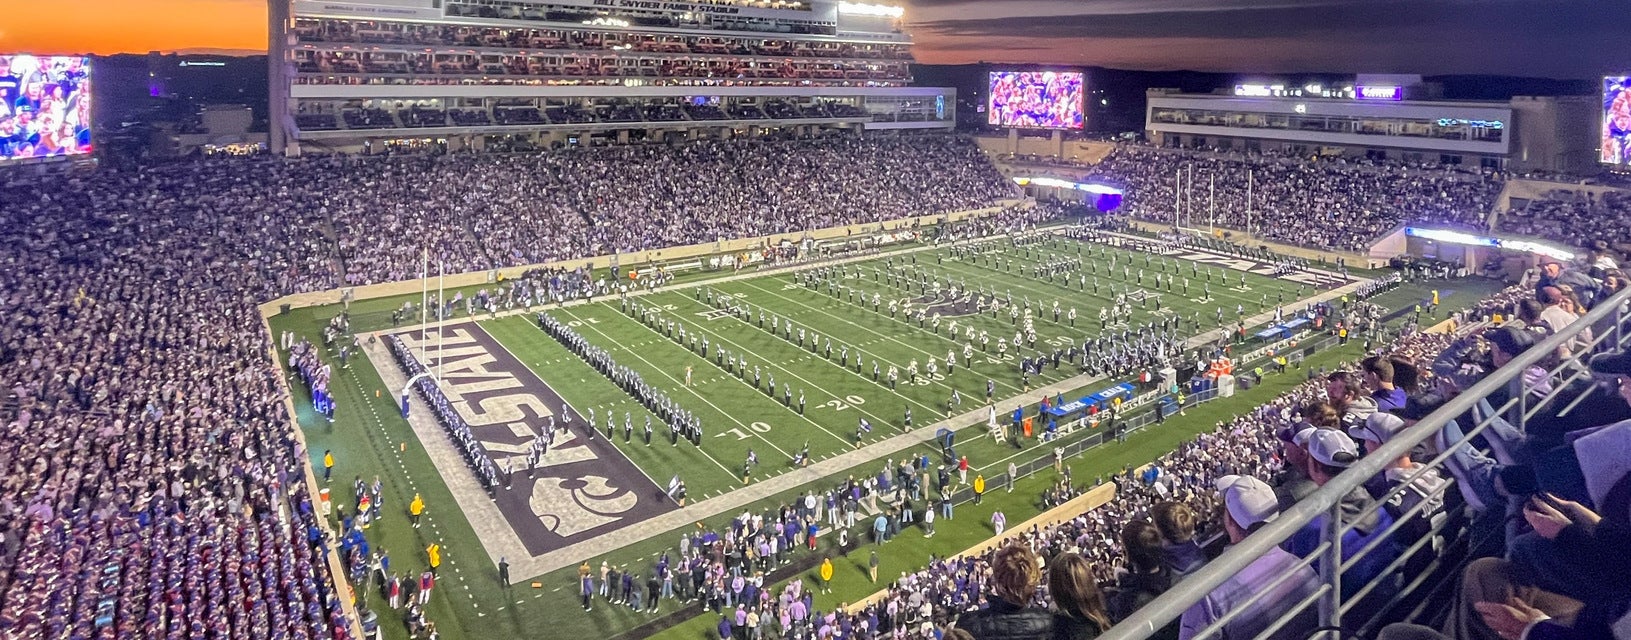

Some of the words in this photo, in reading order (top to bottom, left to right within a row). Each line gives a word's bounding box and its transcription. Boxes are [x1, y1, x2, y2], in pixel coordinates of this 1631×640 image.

[620, 0, 660, 9] SNYDER
[663, 2, 697, 11] FAMILY
[699, 5, 739, 14] STADIUM
[567, 317, 600, 328] 10
[1044, 335, 1074, 347] 50
[396, 328, 599, 473] K-STATE
[826, 394, 866, 411] 20
[726, 421, 772, 441] 10
